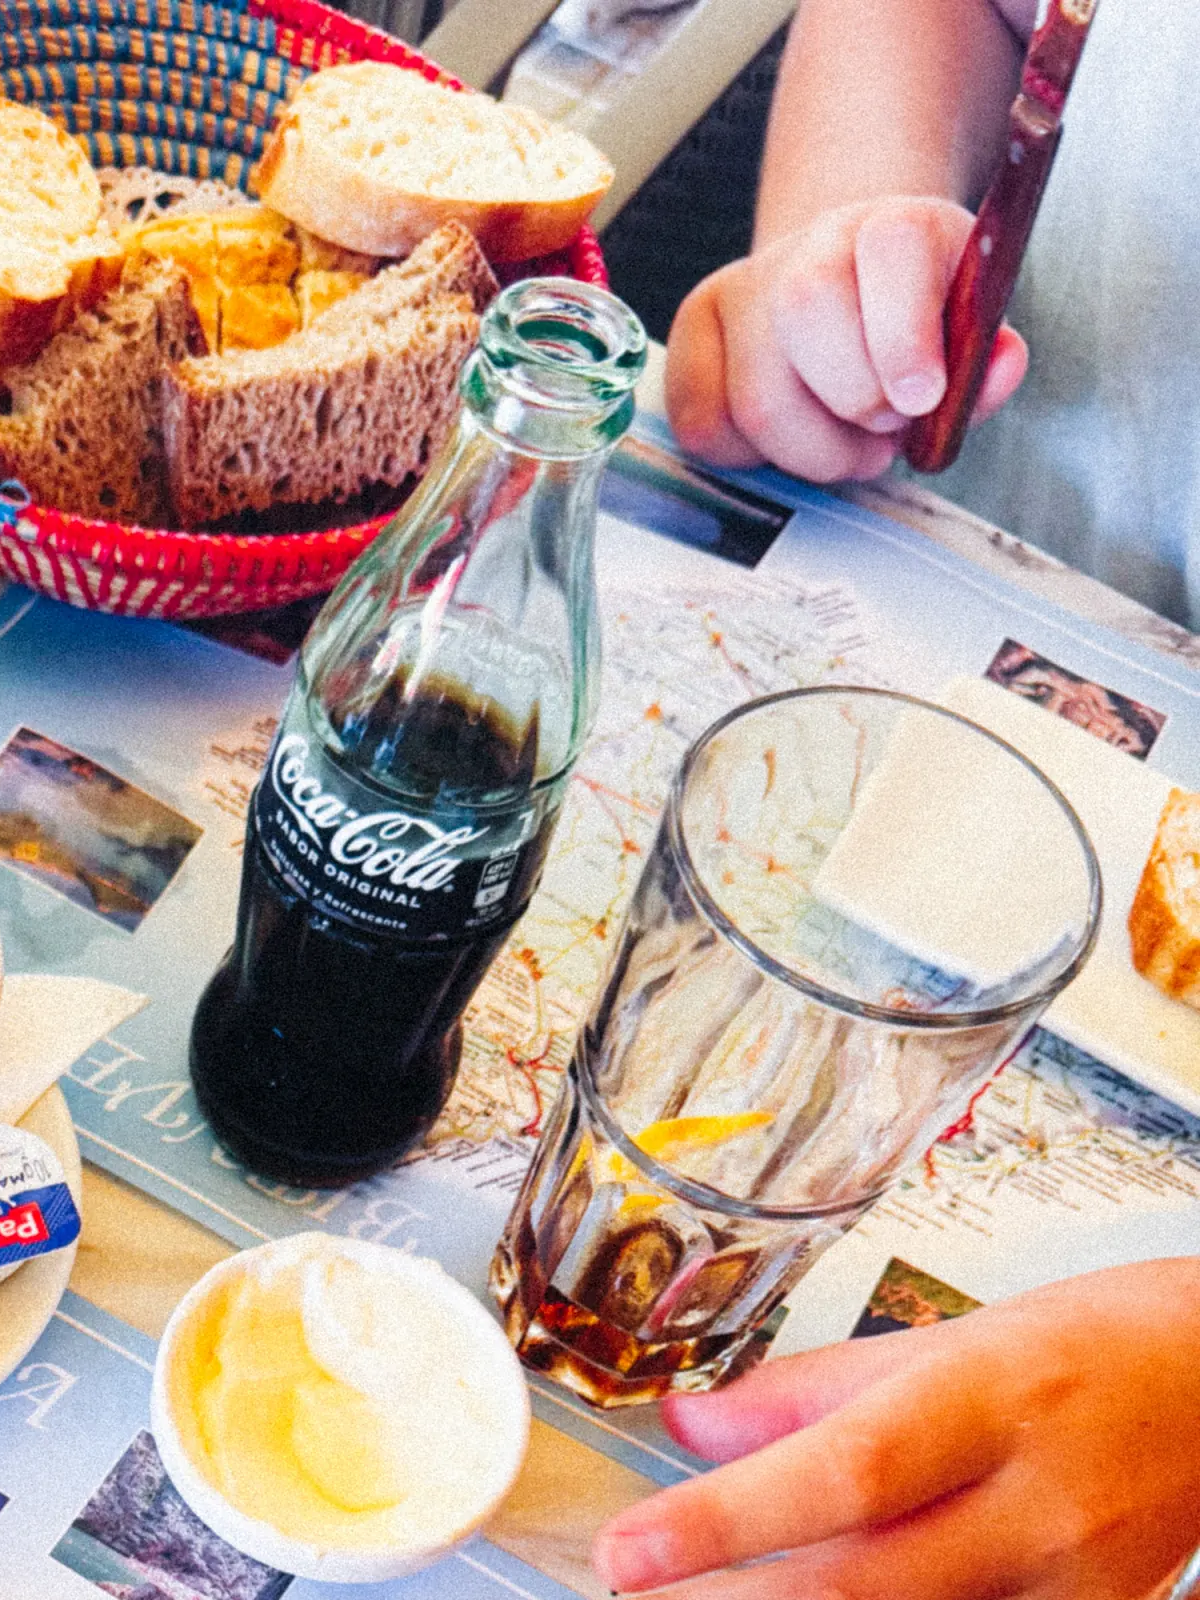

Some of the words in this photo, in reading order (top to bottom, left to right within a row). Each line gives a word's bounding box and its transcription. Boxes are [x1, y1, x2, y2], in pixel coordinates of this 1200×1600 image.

[271, 732, 492, 892] Coca-Cola
[276, 811, 320, 868] SABOR
[323, 863, 423, 910] ORIGINAL
[322, 889, 409, 931] Refrescante
